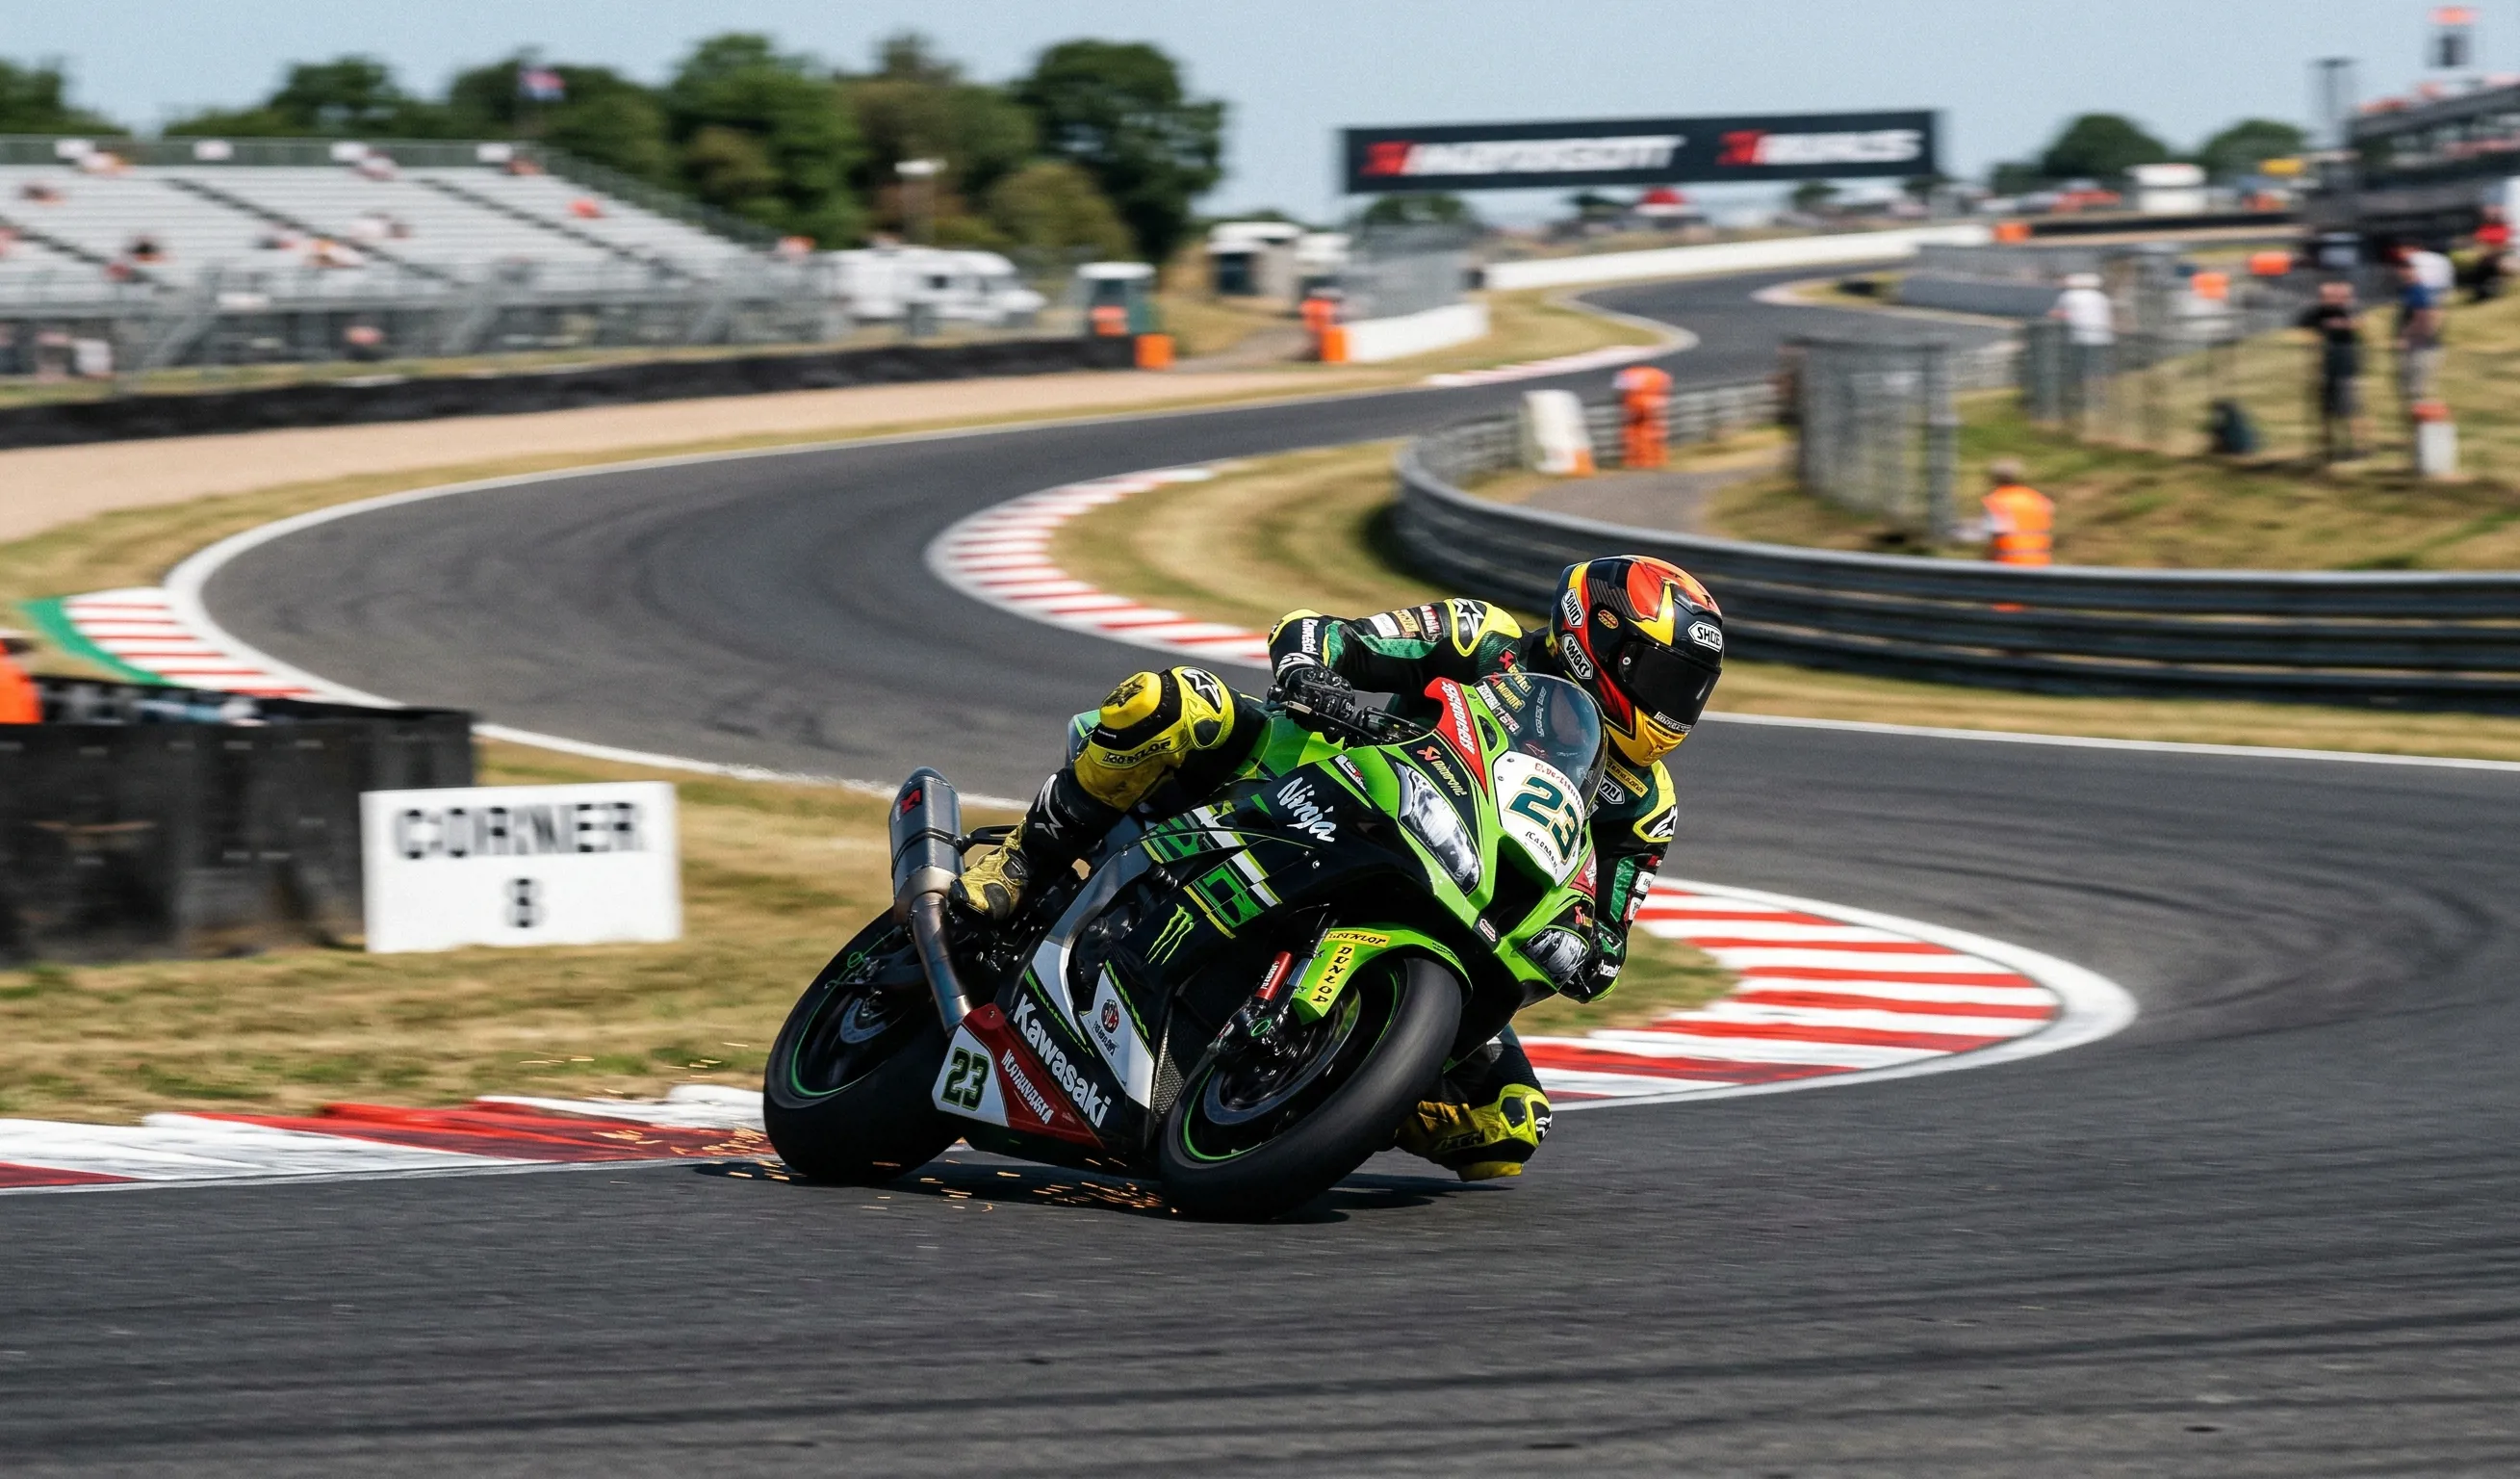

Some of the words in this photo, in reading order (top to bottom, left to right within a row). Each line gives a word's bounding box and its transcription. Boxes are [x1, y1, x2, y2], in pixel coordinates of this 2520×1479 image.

[396, 803, 645, 859] CORNER
[1276, 776, 1337, 843] Ninja
[1504, 774, 1579, 864] 23
[505, 878, 548, 928] 8
[940, 1047, 990, 1112] 23
[1013, 993, 1112, 1129] Kawasaki
